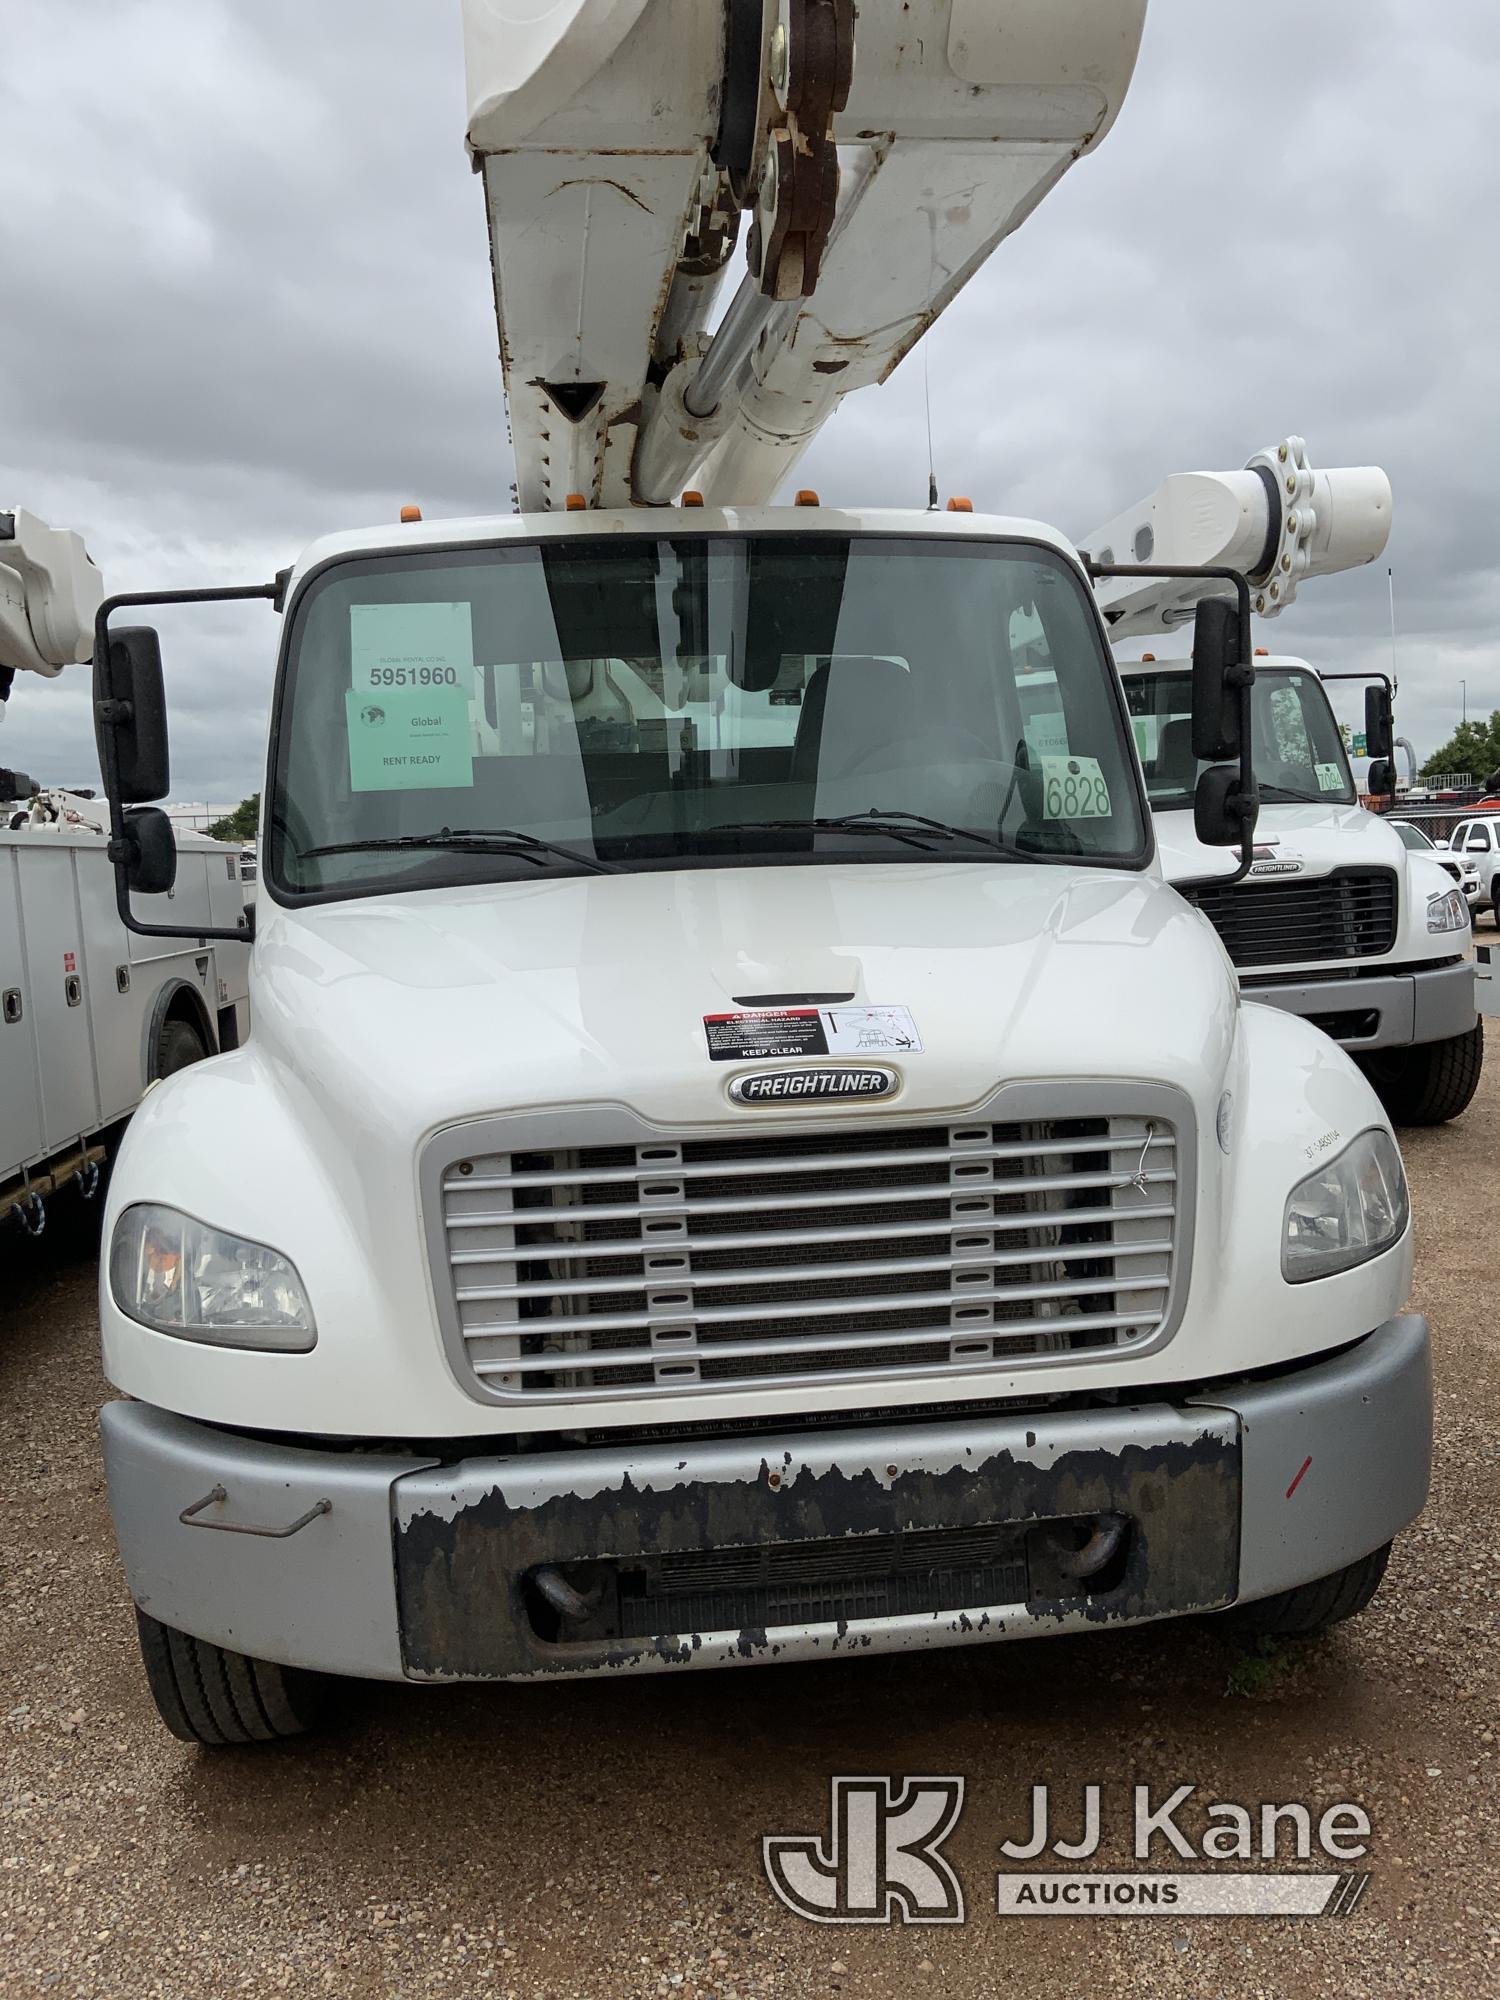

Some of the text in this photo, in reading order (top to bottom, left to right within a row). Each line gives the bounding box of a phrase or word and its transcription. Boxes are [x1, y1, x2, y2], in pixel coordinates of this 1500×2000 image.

[370, 667, 457, 686] 5951960
[411, 716, 442, 727] Global
[383, 755, 441, 766] RENT READY
[1318, 772, 1342, 790] 7094
[1047, 776, 1109, 817] 6828
[1254, 864, 1297, 873] FREIGHTLINER
[742, 1011, 788, 1019] DANGER
[742, 1047, 803, 1057] KEEP CLEAR
[748, 1074, 882, 1097] FREIGHTLINER
